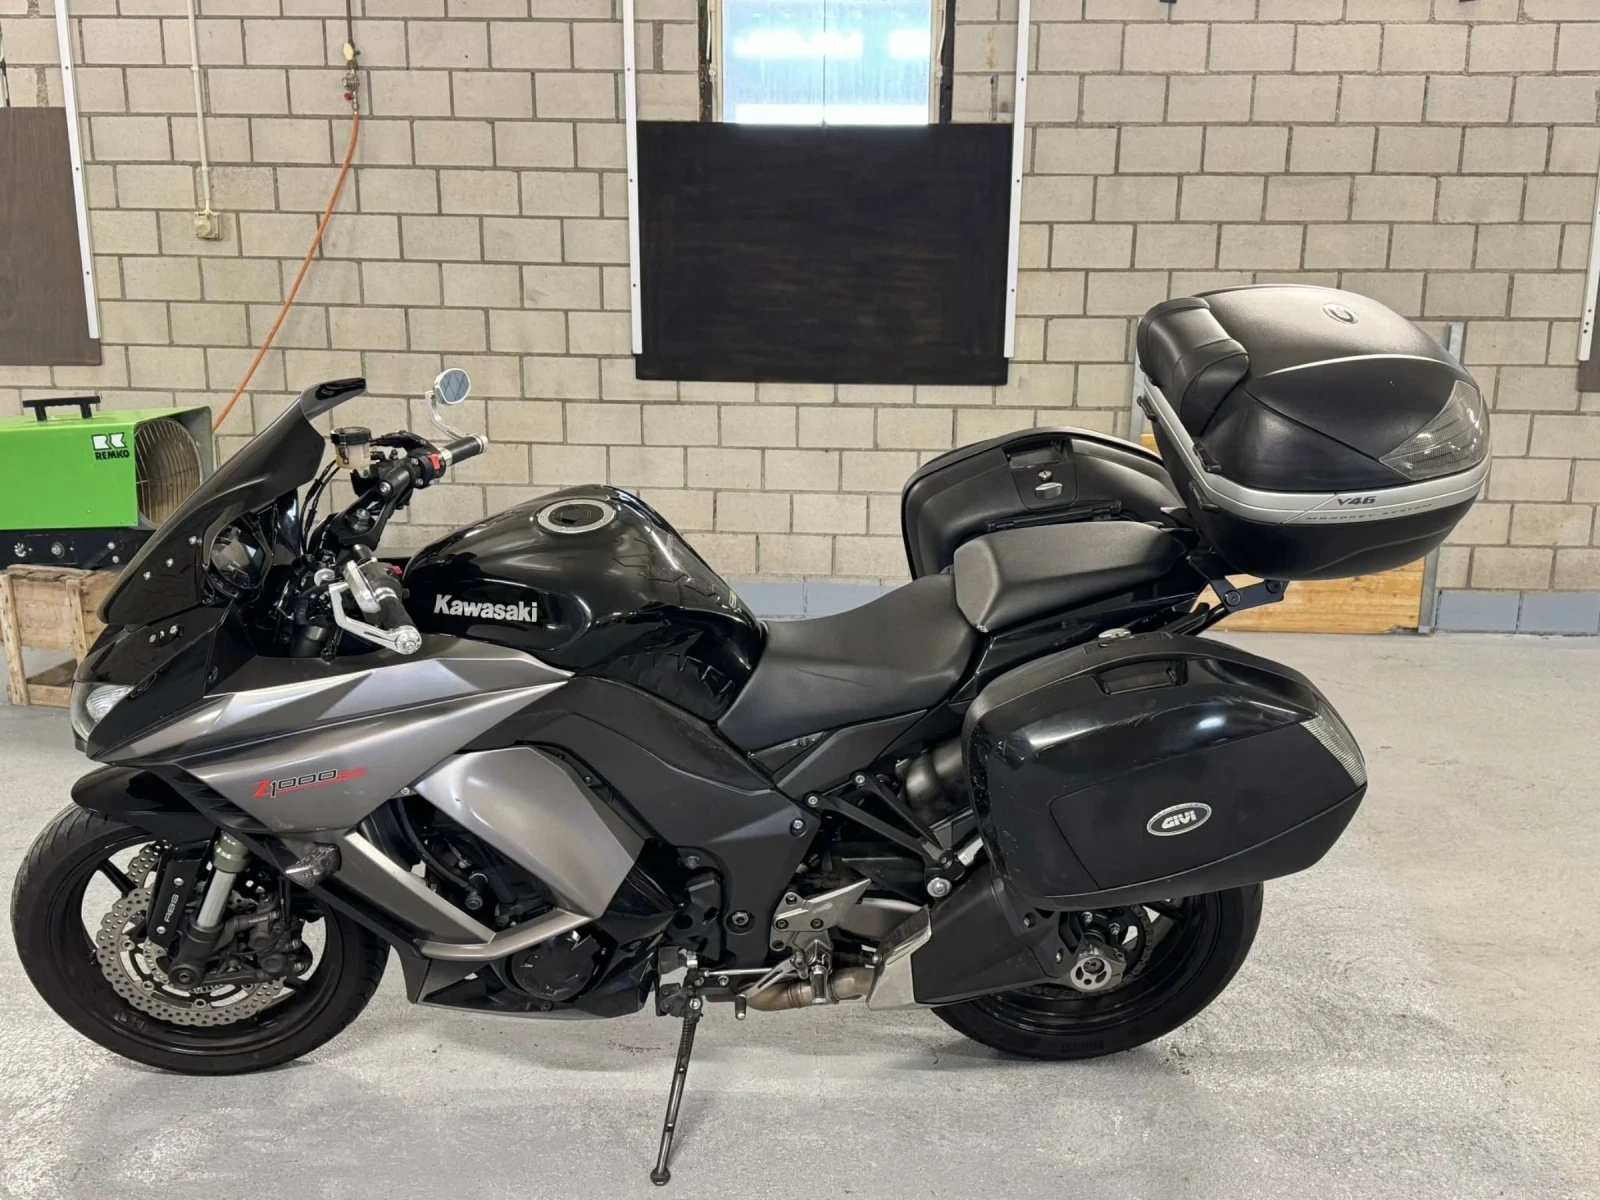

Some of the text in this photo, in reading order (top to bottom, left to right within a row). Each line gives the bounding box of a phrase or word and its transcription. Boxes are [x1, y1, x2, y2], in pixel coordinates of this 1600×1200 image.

[95, 450, 130, 460] REMKO
[1337, 496, 1376, 506] V46
[433, 594, 538, 622] Kawasaki
[1161, 810, 1197, 829] GIVI
[164, 893, 179, 922] ABS
